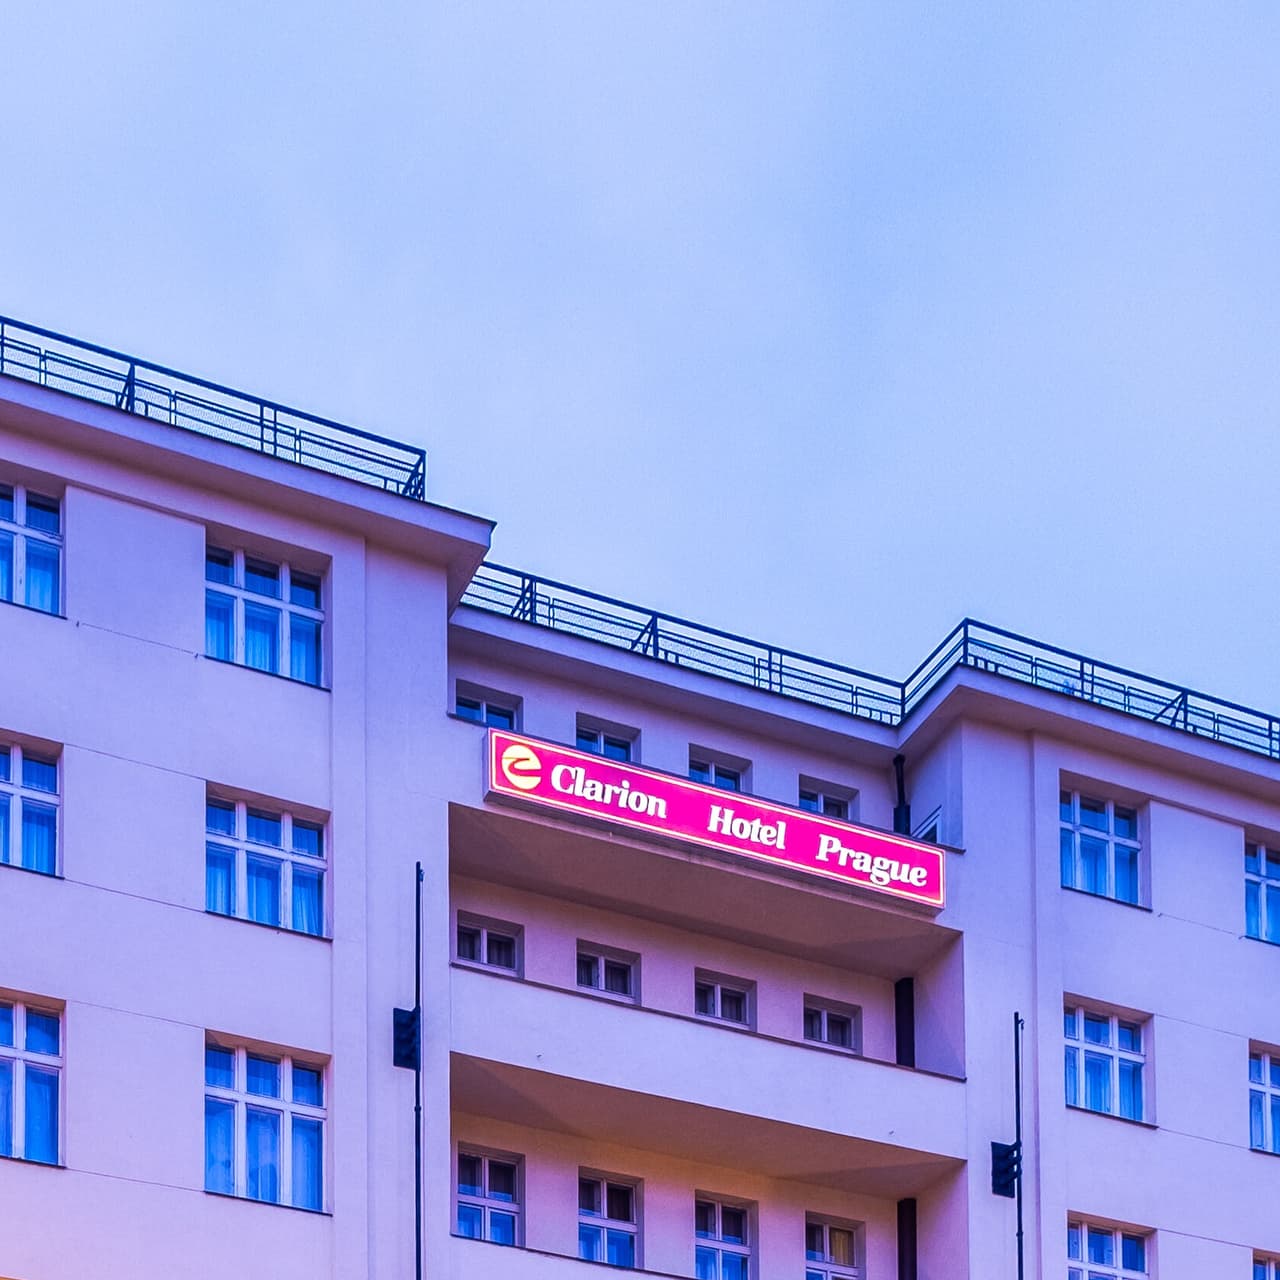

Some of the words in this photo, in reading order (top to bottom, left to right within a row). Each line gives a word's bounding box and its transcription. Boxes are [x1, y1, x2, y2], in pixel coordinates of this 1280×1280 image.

[551, 764, 667, 819] Clarion
[707, 804, 786, 850] Hotel
[816, 833, 927, 886] Prague
